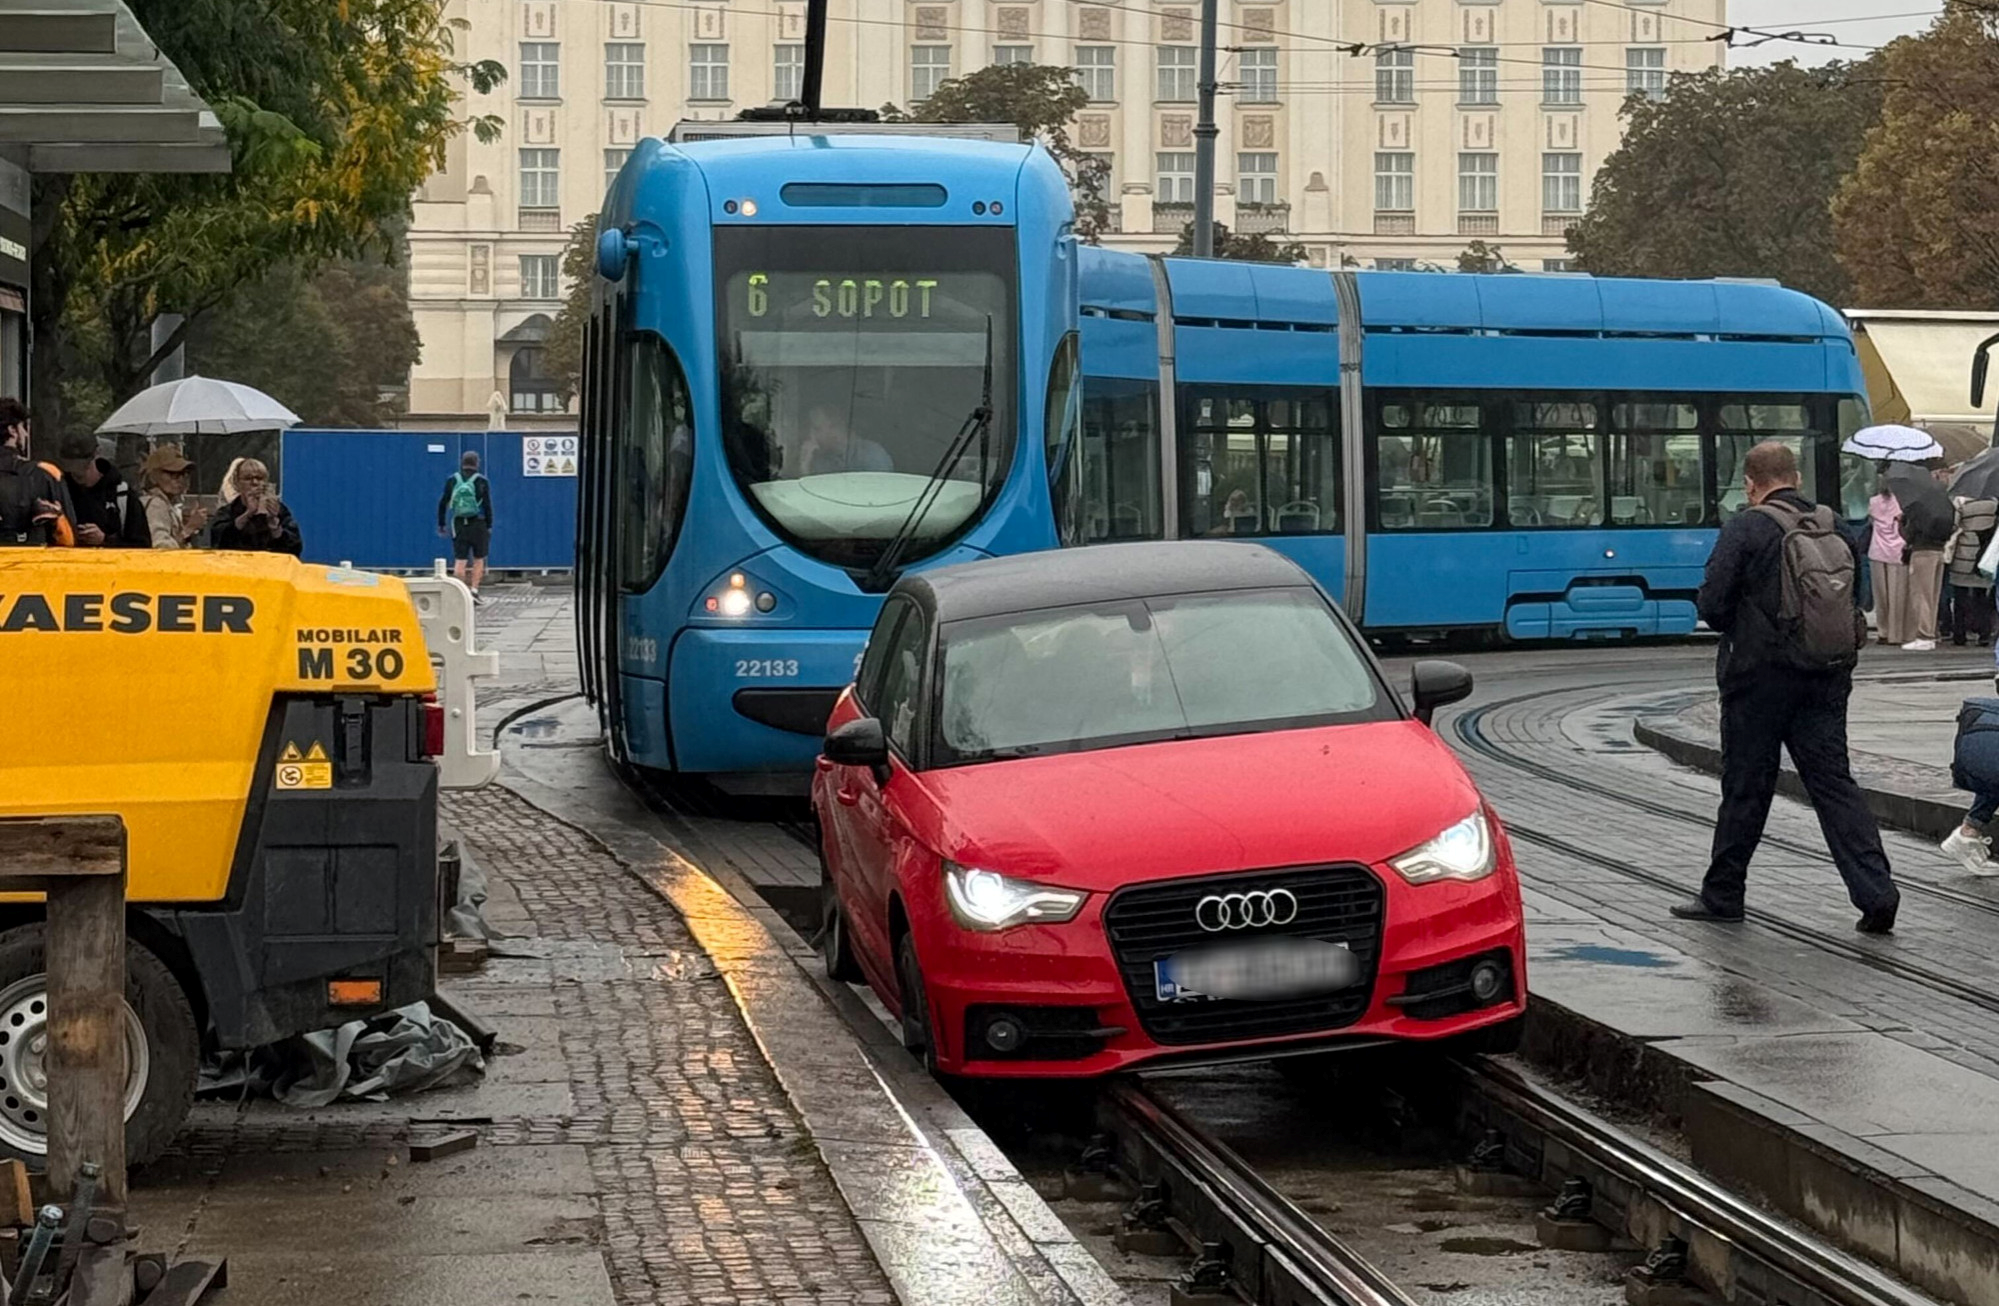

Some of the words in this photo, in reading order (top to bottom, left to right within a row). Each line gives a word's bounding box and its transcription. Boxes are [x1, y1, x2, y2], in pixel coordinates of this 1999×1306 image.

[748, 274, 768, 317] 6
[812, 280, 938, 318] SOPOT
[0, 592, 254, 634] AESER
[297, 629, 402, 643] MOBILAIR
[298, 648, 334, 680] M
[346, 648, 404, 680] 30
[735, 659, 799, 677] 22133
